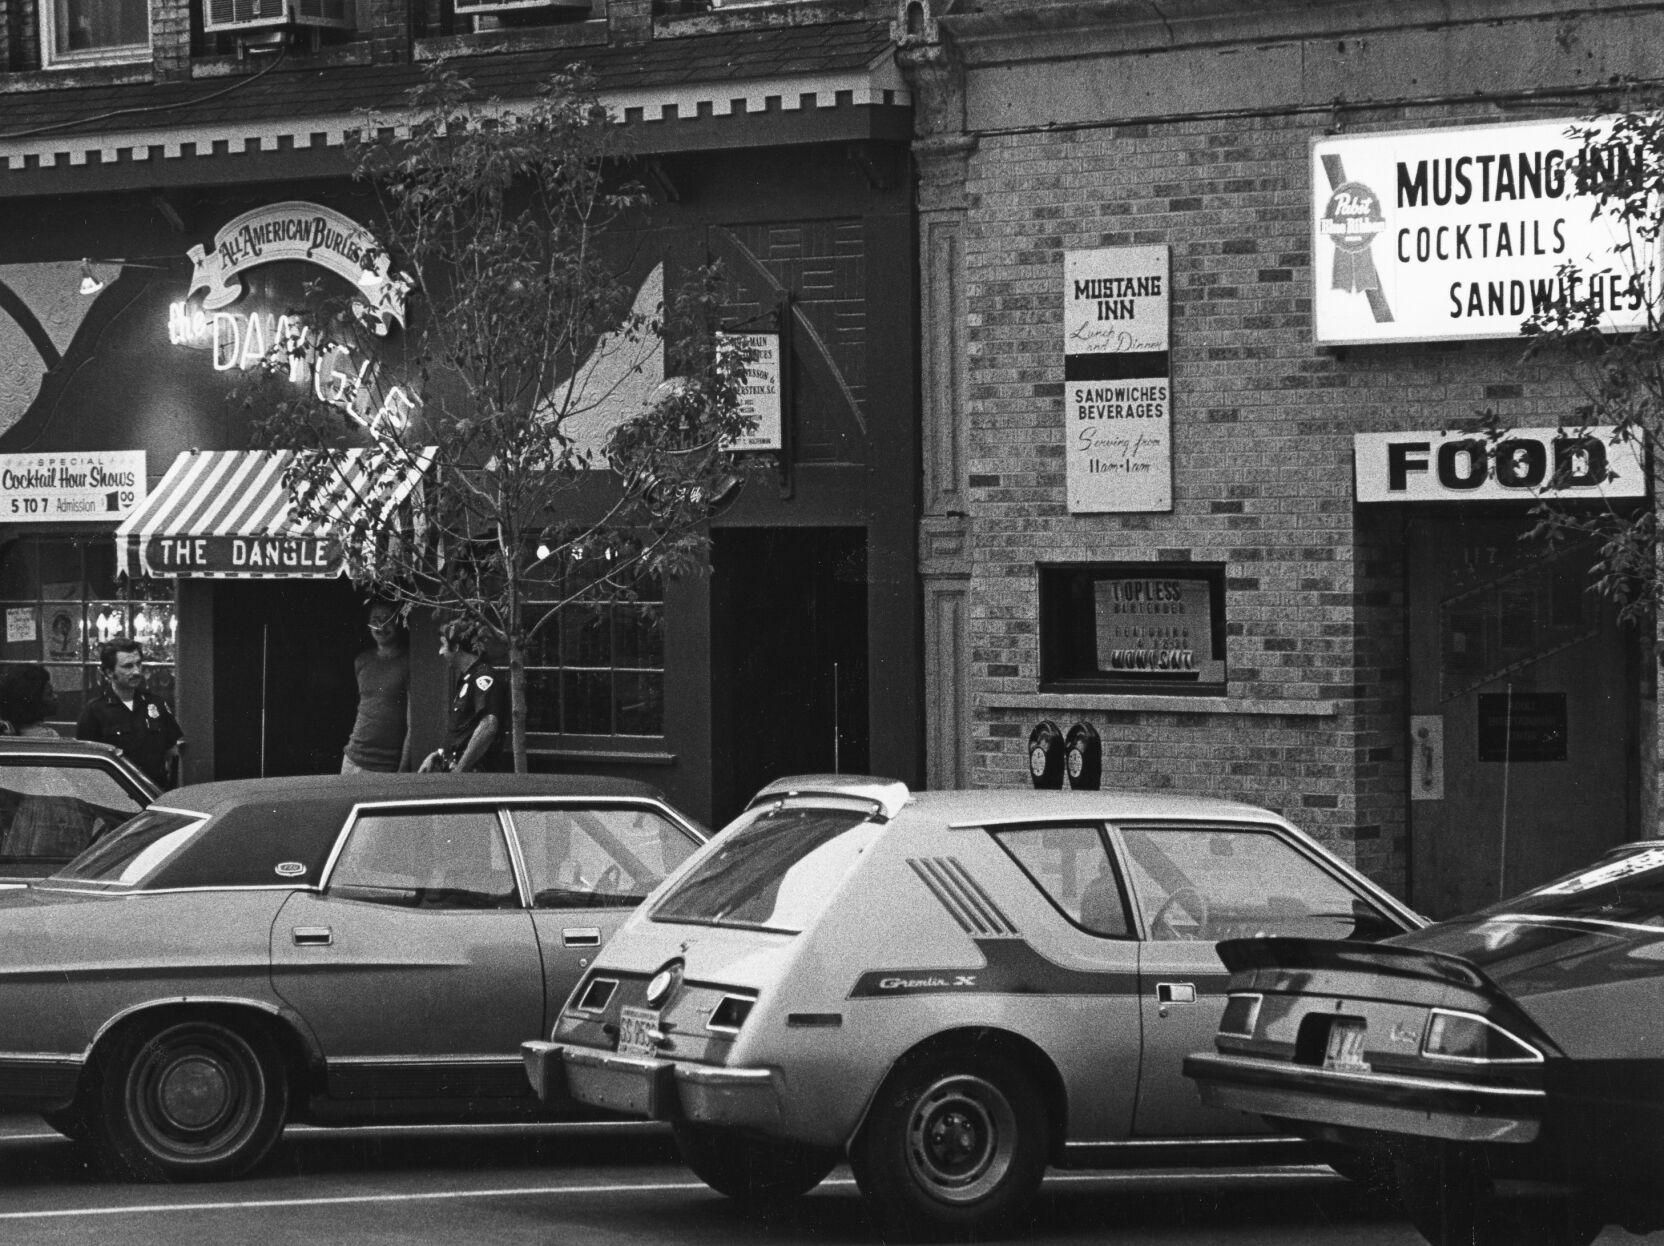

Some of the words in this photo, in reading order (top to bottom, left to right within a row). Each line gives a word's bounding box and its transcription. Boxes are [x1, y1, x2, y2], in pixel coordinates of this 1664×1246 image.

[1396, 148, 1565, 208] MUSTANG
[1334, 192, 1373, 216] Pabst
[239, 218, 313, 257] AMERICAN
[1397, 217, 1566, 262] COCKTAILS
[1074, 275, 1162, 300] MUSTANG
[1449, 273, 1644, 319] SANDWICHES
[1097, 299, 1135, 321] INN
[1070, 320, 1115, 341] Lunch
[1117, 331, 1163, 353] Dinner
[1075, 386, 1167, 403] SANDWICHES
[1078, 403, 1164, 420] BEVERAGES
[1079, 426, 1130, 457] Serving
[1132, 434, 1161, 458] from
[37, 458, 104, 467] SPECIAL
[1387, 436, 1608, 492] FOOD
[2, 466, 57, 490] Cocktail
[58, 466, 87, 488] Hour
[89, 466, 135, 488] Shows
[11, 498, 20, 513] 5
[23, 498, 38, 513] TO
[41, 497, 49, 513] 7
[56, 497, 96, 513] Admission
[160, 539, 207, 565] THE
[232, 539, 329, 566] DANGLE
[1112, 580, 1182, 601] TOPLESS
[952, 975, 976, 986] X
